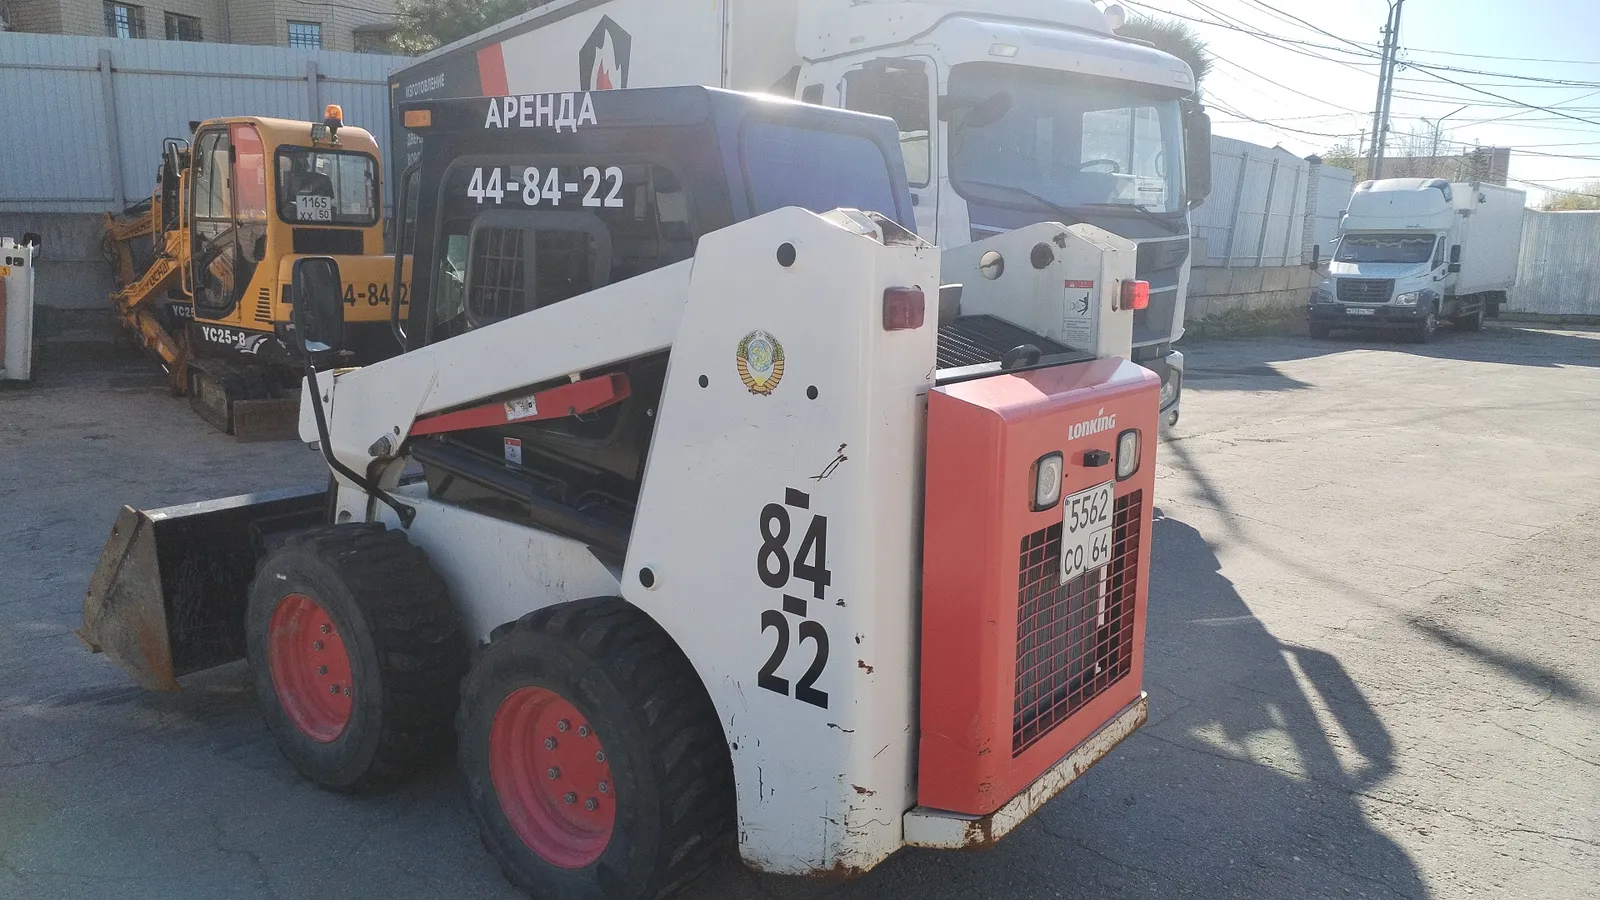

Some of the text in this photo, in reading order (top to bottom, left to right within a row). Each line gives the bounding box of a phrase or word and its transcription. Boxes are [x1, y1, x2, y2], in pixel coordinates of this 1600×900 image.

[405, 73, 445, 98] ИЗГОТОВЛЕНИЕ
[484, 91, 598, 133] АРЕНДА
[302, 197, 327, 208] 1165
[467, 166, 623, 207] 44-84-22
[319, 210, 329, 219] 50
[202, 326, 246, 346] YC25-8
[1070, 489, 1109, 533] 5562
[757, 503, 831, 600] 84
[1092, 533, 1108, 563] 64
[757, 609, 829, 709] 22
